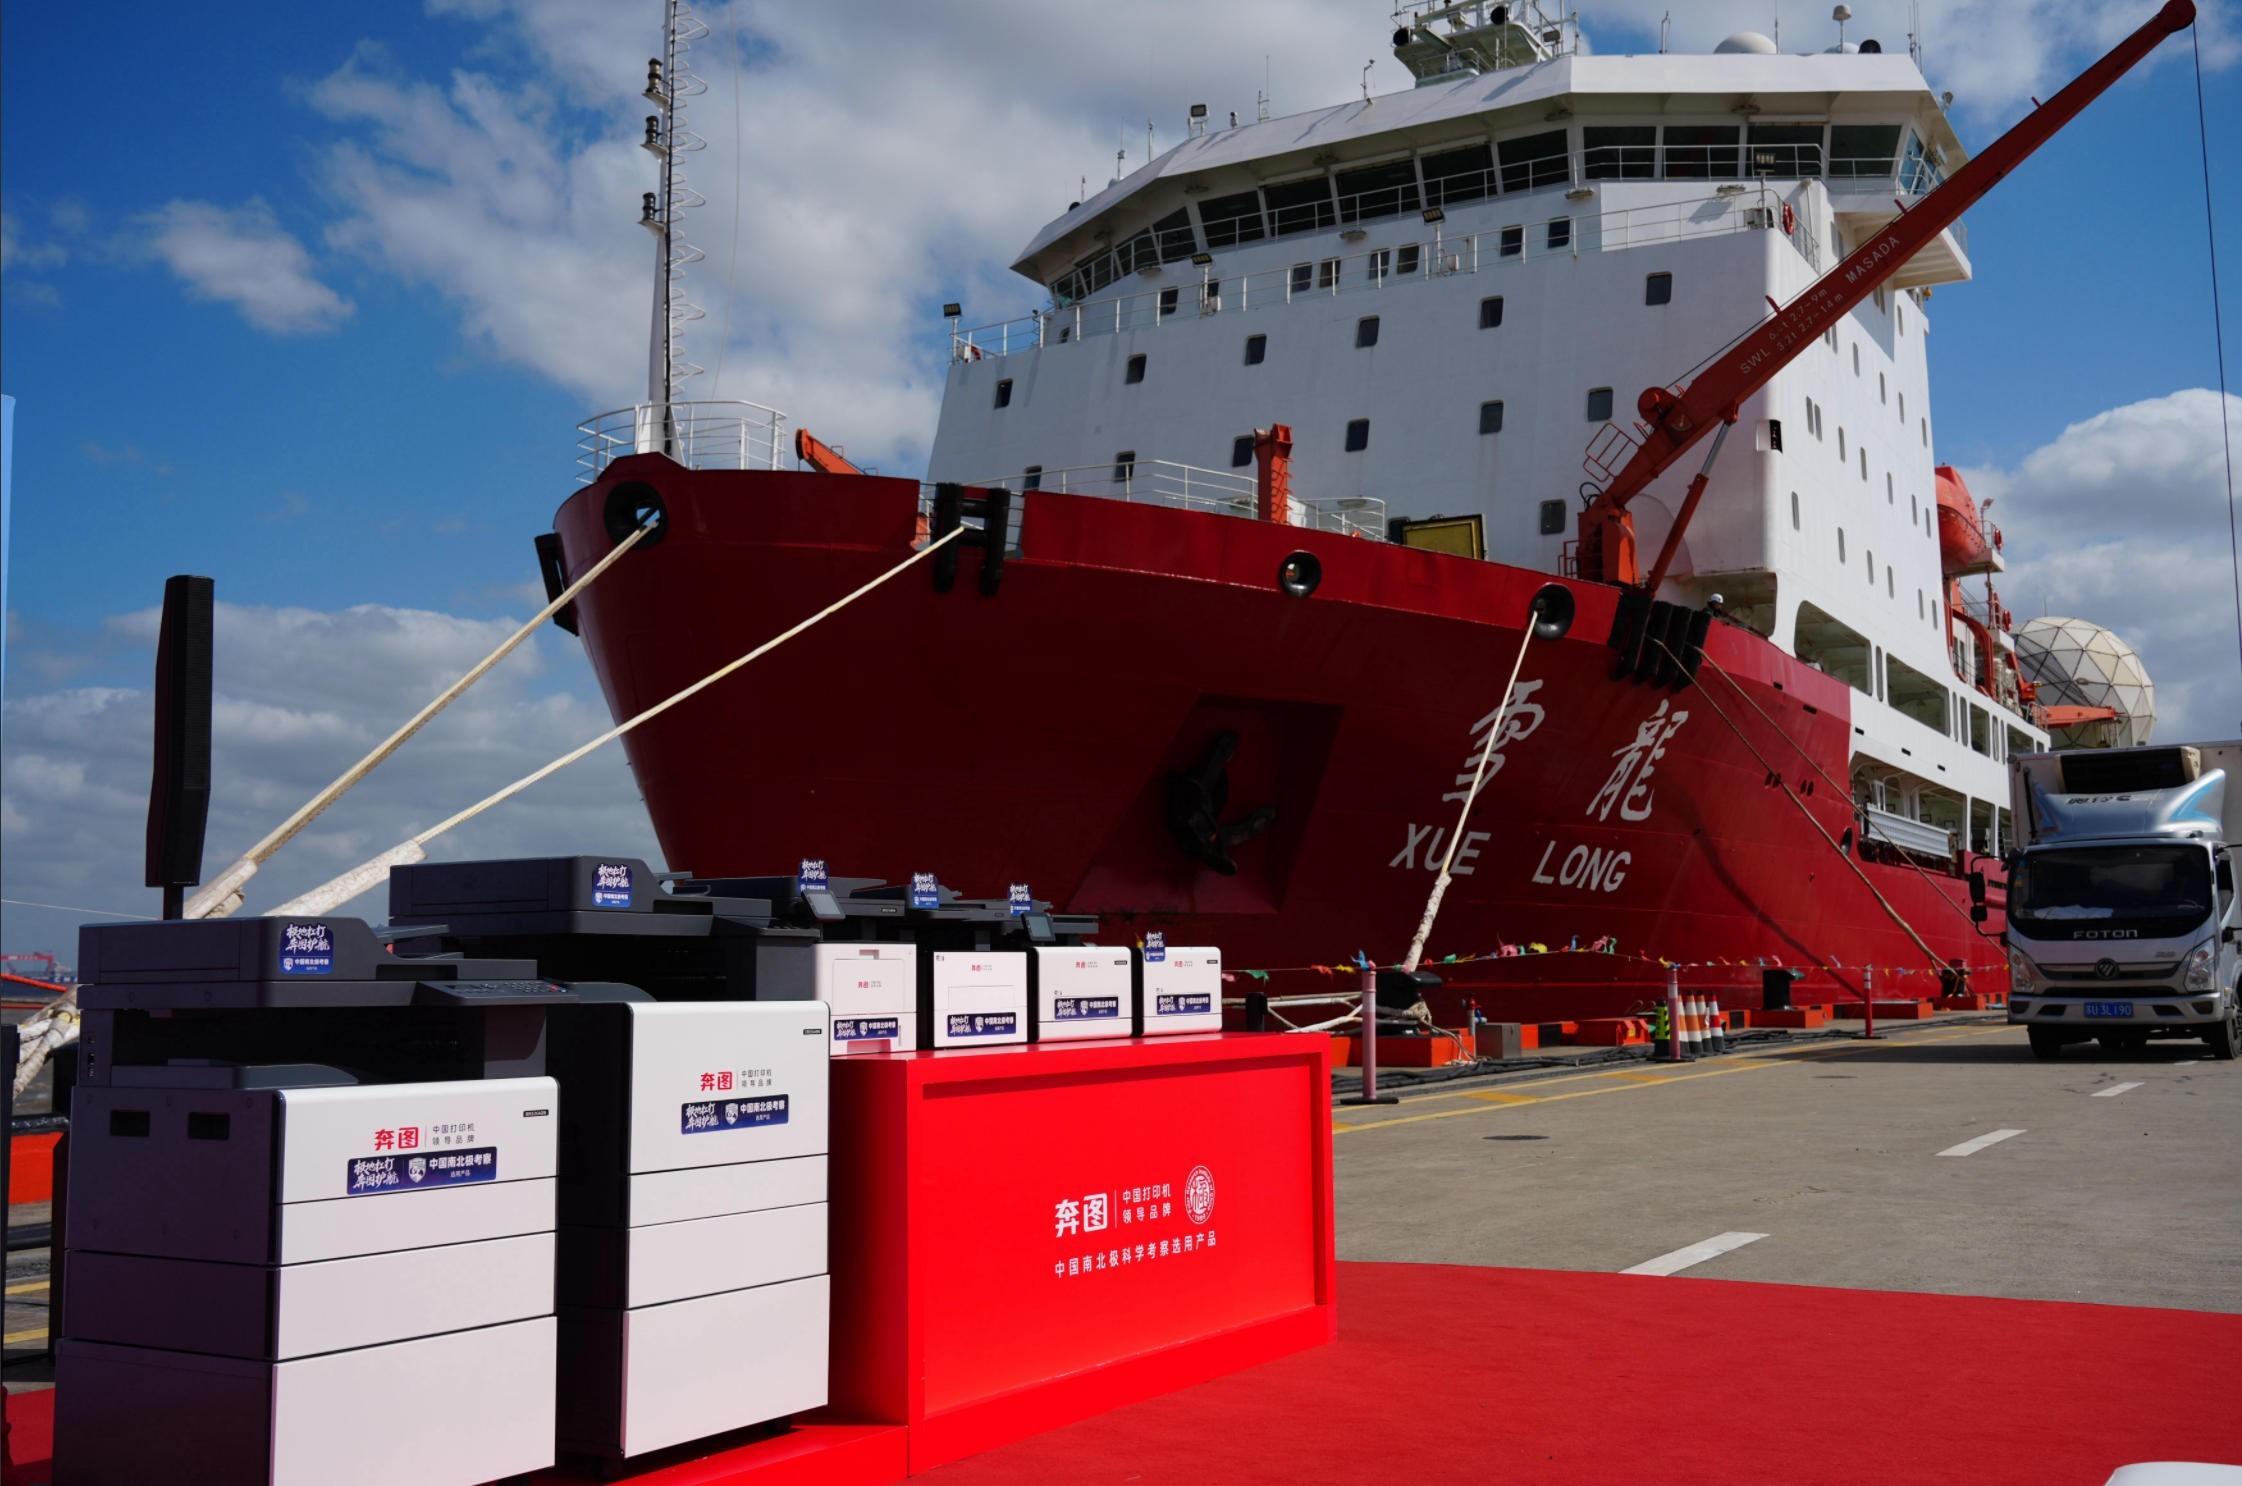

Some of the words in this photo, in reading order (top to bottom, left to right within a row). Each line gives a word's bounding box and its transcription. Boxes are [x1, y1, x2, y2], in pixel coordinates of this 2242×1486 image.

[1845, 236, 1900, 284] MASADA
[1740, 348, 1771, 374] SWL
[1389, 823, 1491, 876] XUE
[1532, 841, 1631, 892] LONG
[2073, 929, 2138, 939] FOTON
[700, 1071, 732, 1091] 奔图
[374, 1127, 418, 1151] 奔图
[432, 1123, 475, 1134] 中国打印机
[429, 1153, 492, 1170] 中国南北极考察
[1122, 1183, 1172, 1204] 中国打印机
[1055, 1193, 1107, 1237] 奔图
[1122, 1202, 1172, 1224] 领导品牌
[1055, 1230, 1216, 1278] 中国南北极科学考察选用产品
